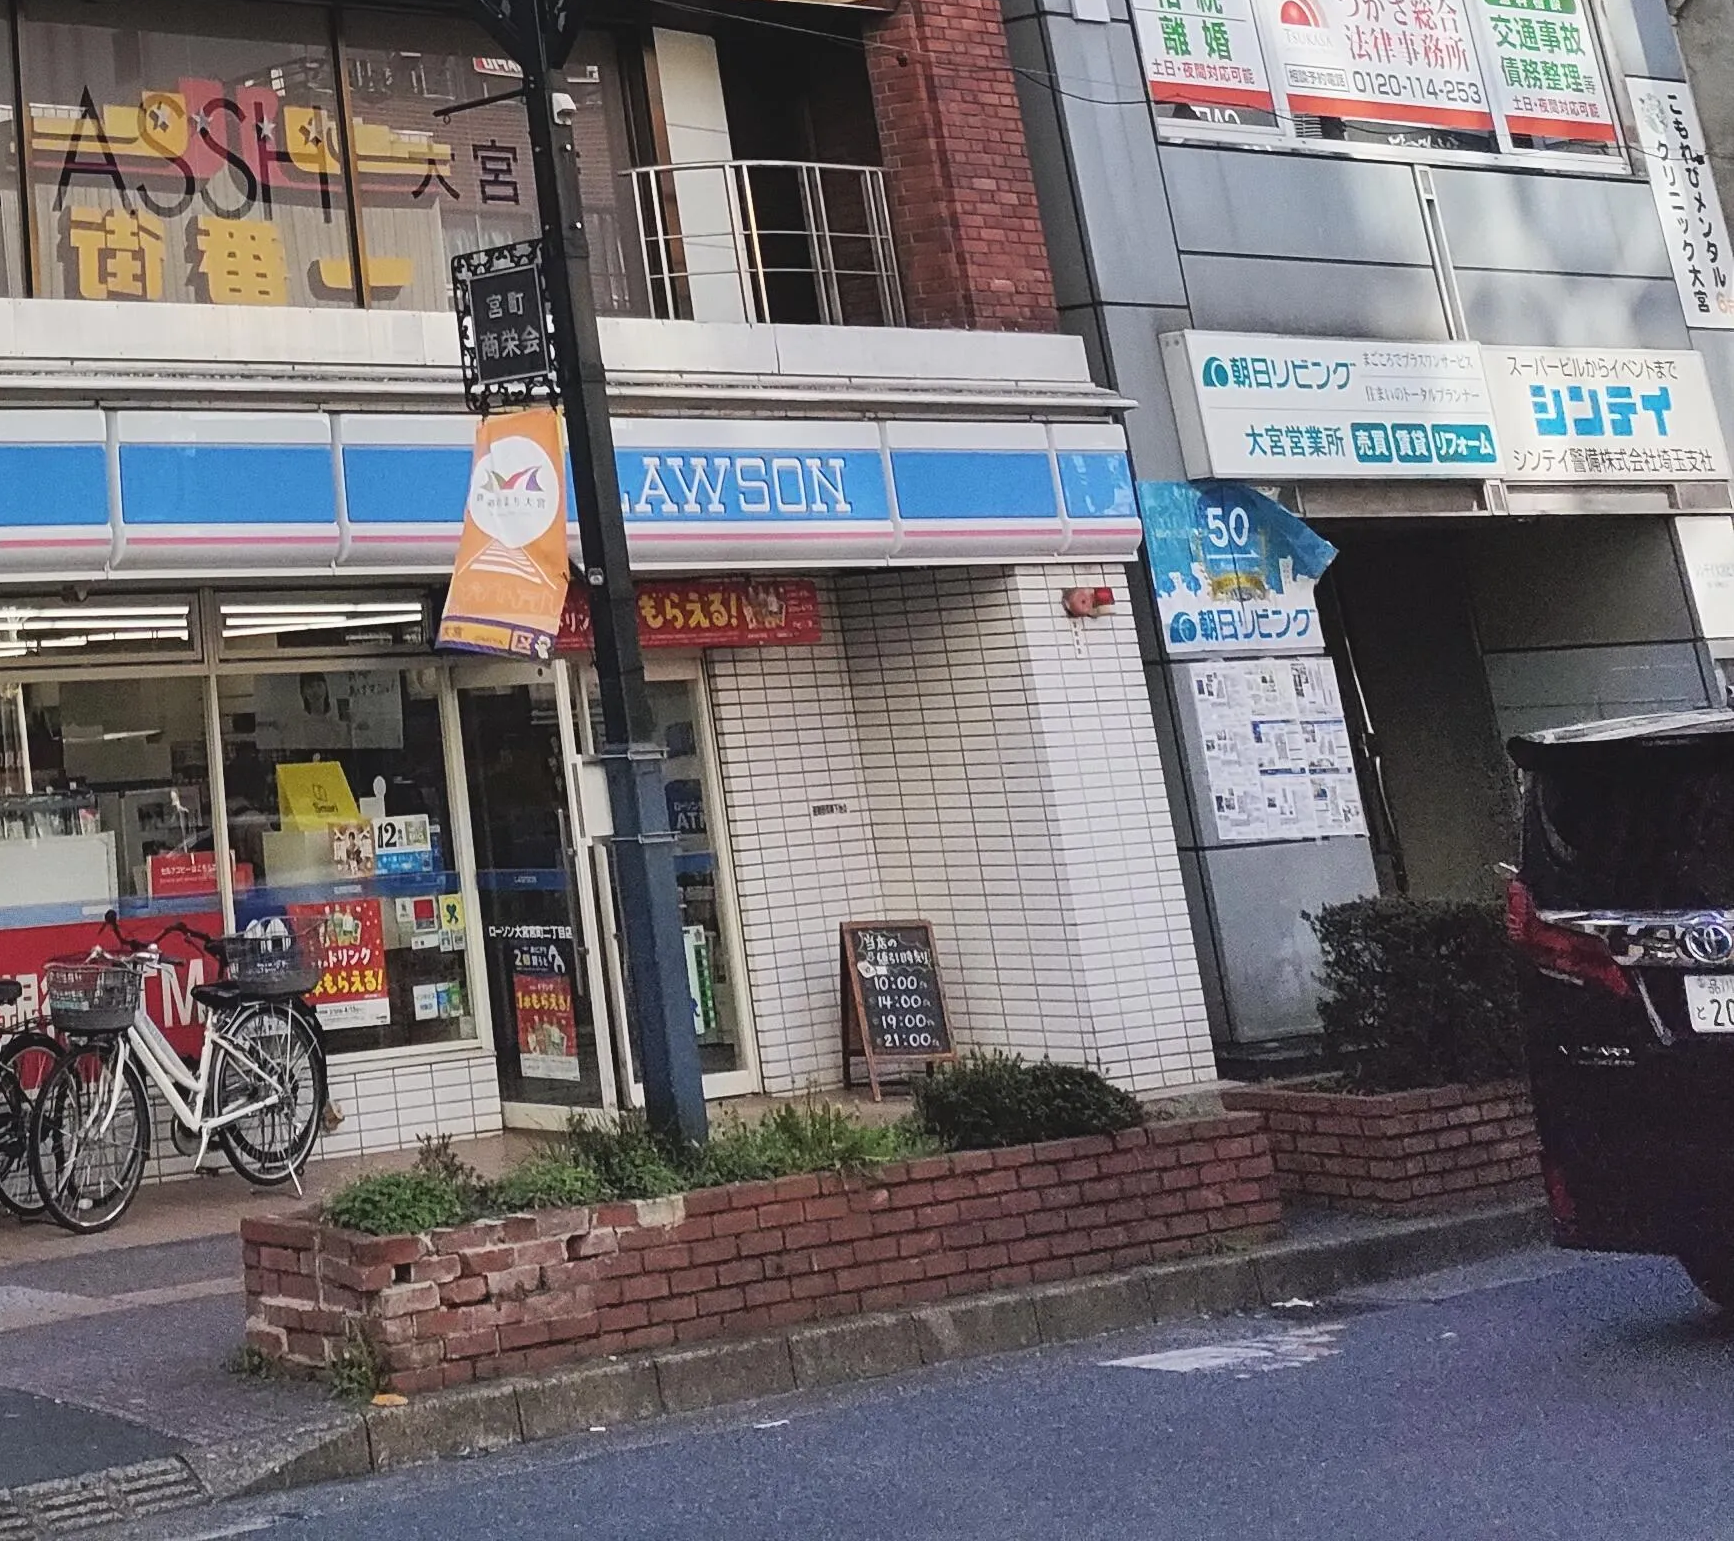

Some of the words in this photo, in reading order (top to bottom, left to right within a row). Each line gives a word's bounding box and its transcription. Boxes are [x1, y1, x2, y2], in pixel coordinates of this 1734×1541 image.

[1159, 15, 1232, 61] 離婚
[1344, 24, 1469, 72] 法律事務所
[1490, 14, 1586, 57] 交通事故
[1152, 58, 1255, 85] 土日・夜間対応可能
[1352, 70, 1483, 105] 0120-114-253
[1512, 94, 1600, 119] 土日・夜間対応可能
[1657, 141, 1710, 313] クリニック大宮
[486, 291, 525, 319] 宮町
[480, 325, 542, 360] 商栄会
[1229, 356, 1357, 391] 朝日リビング
[1529, 384, 1673, 438] シンテイ
[1245, 423, 1346, 458] 大宮営業所
[1358, 429, 1389, 458] 売買
[1397, 428, 1429, 458] 賃貸
[1436, 429, 1495, 457] リフォーム
[1513, 447, 1716, 474] シンテイ警備株式会社埼玉支社
[621, 456, 853, 516] AWSON
[1207, 506, 1250, 548] 50
[1198, 608, 1316, 642] 朝日リビング
[874, 975, 918, 991] 10:00
[877, 994, 922, 1010] 14:00
[881, 1013, 927, 1030] 19:00
[884, 1032, 932, 1048] 21:00
